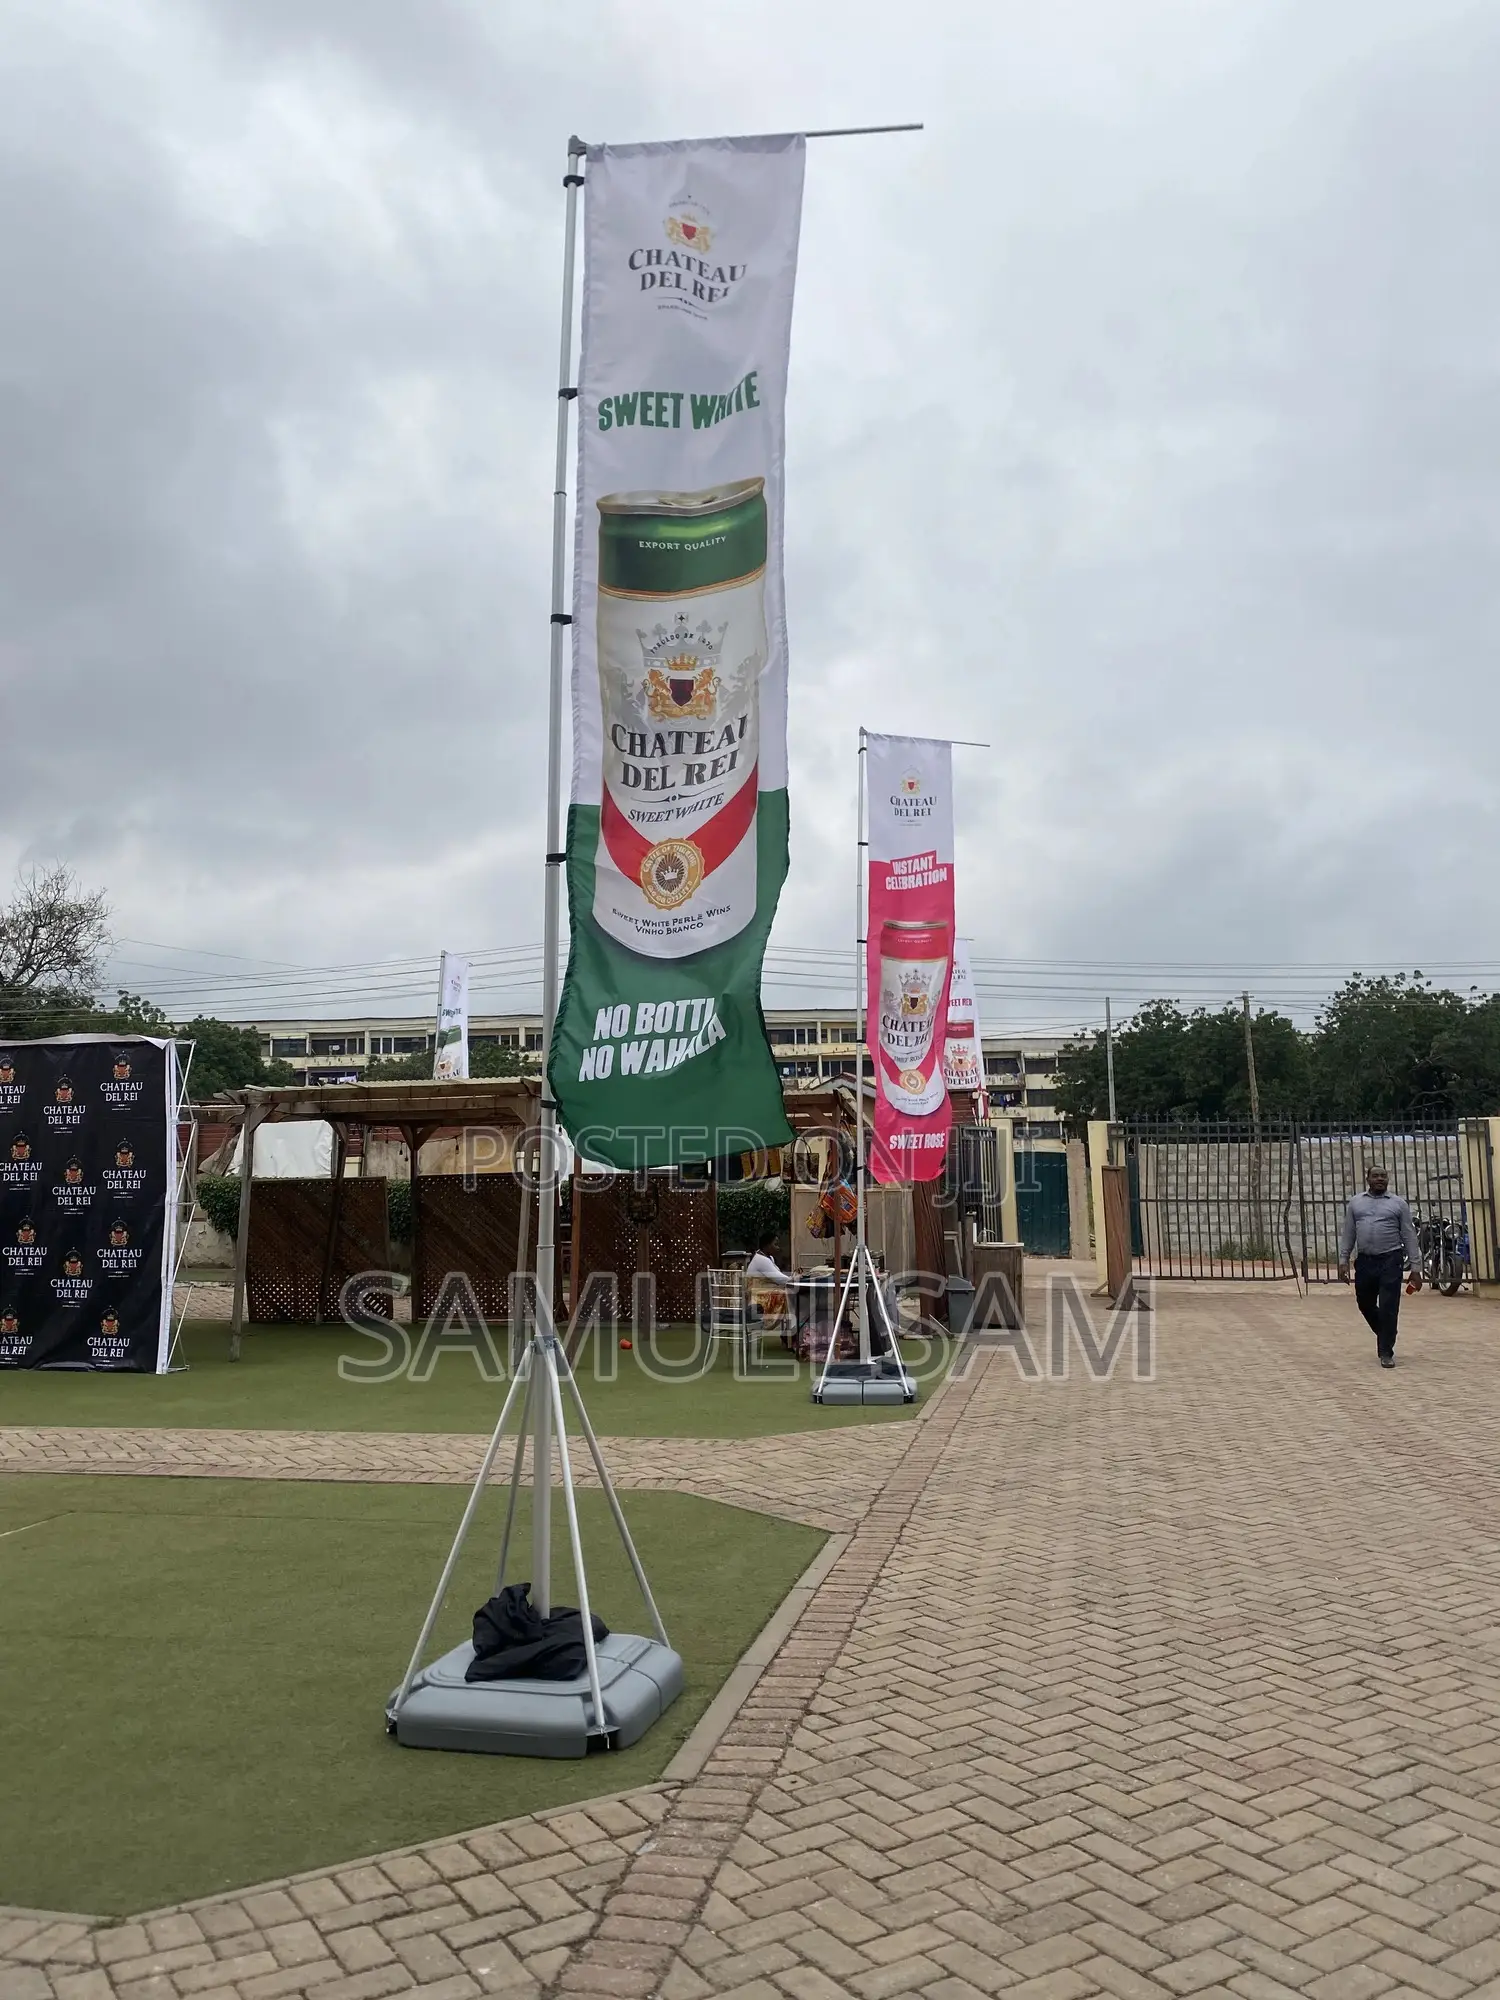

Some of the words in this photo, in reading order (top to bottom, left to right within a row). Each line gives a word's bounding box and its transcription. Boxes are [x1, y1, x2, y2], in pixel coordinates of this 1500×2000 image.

[629, 249, 747, 283] CHATEAU
[640, 271, 687, 291] DEL
[692, 279, 730, 303] REI
[598, 391, 684, 431] SWEET
[690, 371, 761, 430] WHITE
[638, 540, 680, 551] EXPORT
[684, 535, 727, 551] QUALITY
[620, 761, 676, 792] DEL
[681, 749, 740, 787] REI
[890, 795, 937, 807] CHATEAU
[627, 808, 674, 823] SWEET
[676, 792, 725, 819] WHITE
[894, 807, 911, 817] DEL
[913, 807, 931, 817] REI
[885, 867, 948, 890] CELEBRATION
[635, 925, 664, 936] VINHO
[666, 921, 704, 936] BRANCO
[641, 919, 670, 928] WHITE
[593, 1003, 631, 1041] NO
[887, 1032, 912, 1048] DEL
[578, 1044, 615, 1082] NO
[620, 1012, 727, 1076] WAHALA
[100, 1082, 143, 1092] CHATEAU
[7, 1095, 20, 1104] REI
[105, 1092, 121, 1102] DEL
[123, 1092, 138, 1101] REI
[43, 1105, 86, 1115] CHATEAU
[48, 1116, 64, 1125] DEL
[66, 1115, 81, 1124] REI
[889, 1134, 923, 1150] SWEET
[0, 1162, 43, 1171] CHATEAU
[3, 1172, 21, 1181] DEL
[23, 1172, 38, 1181] REI
[102, 1170, 147, 1179] CHATEAU
[107, 1180, 124, 1189] DEL
[126, 1179, 141, 1189] REI
[52, 1187, 97, 1196] CHATEAU
[57, 1197, 74, 1206] DEL
[76, 1197, 91, 1206] REI
[3, 1247, 47, 1257] CHATEAU
[97, 1249, 142, 1259] CHATEAU
[8, 1257, 25, 1266] DEL
[27, 1257, 42, 1266] REI
[102, 1259, 119, 1269] DEL
[121, 1259, 137, 1269] REI
[50, 1279, 93, 1289] CHATEAU
[56, 1289, 73, 1299] DEL
[74, 1289, 88, 1299] REI
[87, 1337, 130, 1347] CHATEAU
[11, 1346, 27, 1355] REI
[91, 1348, 108, 1357] DEL
[110, 1348, 124, 1358] REI
